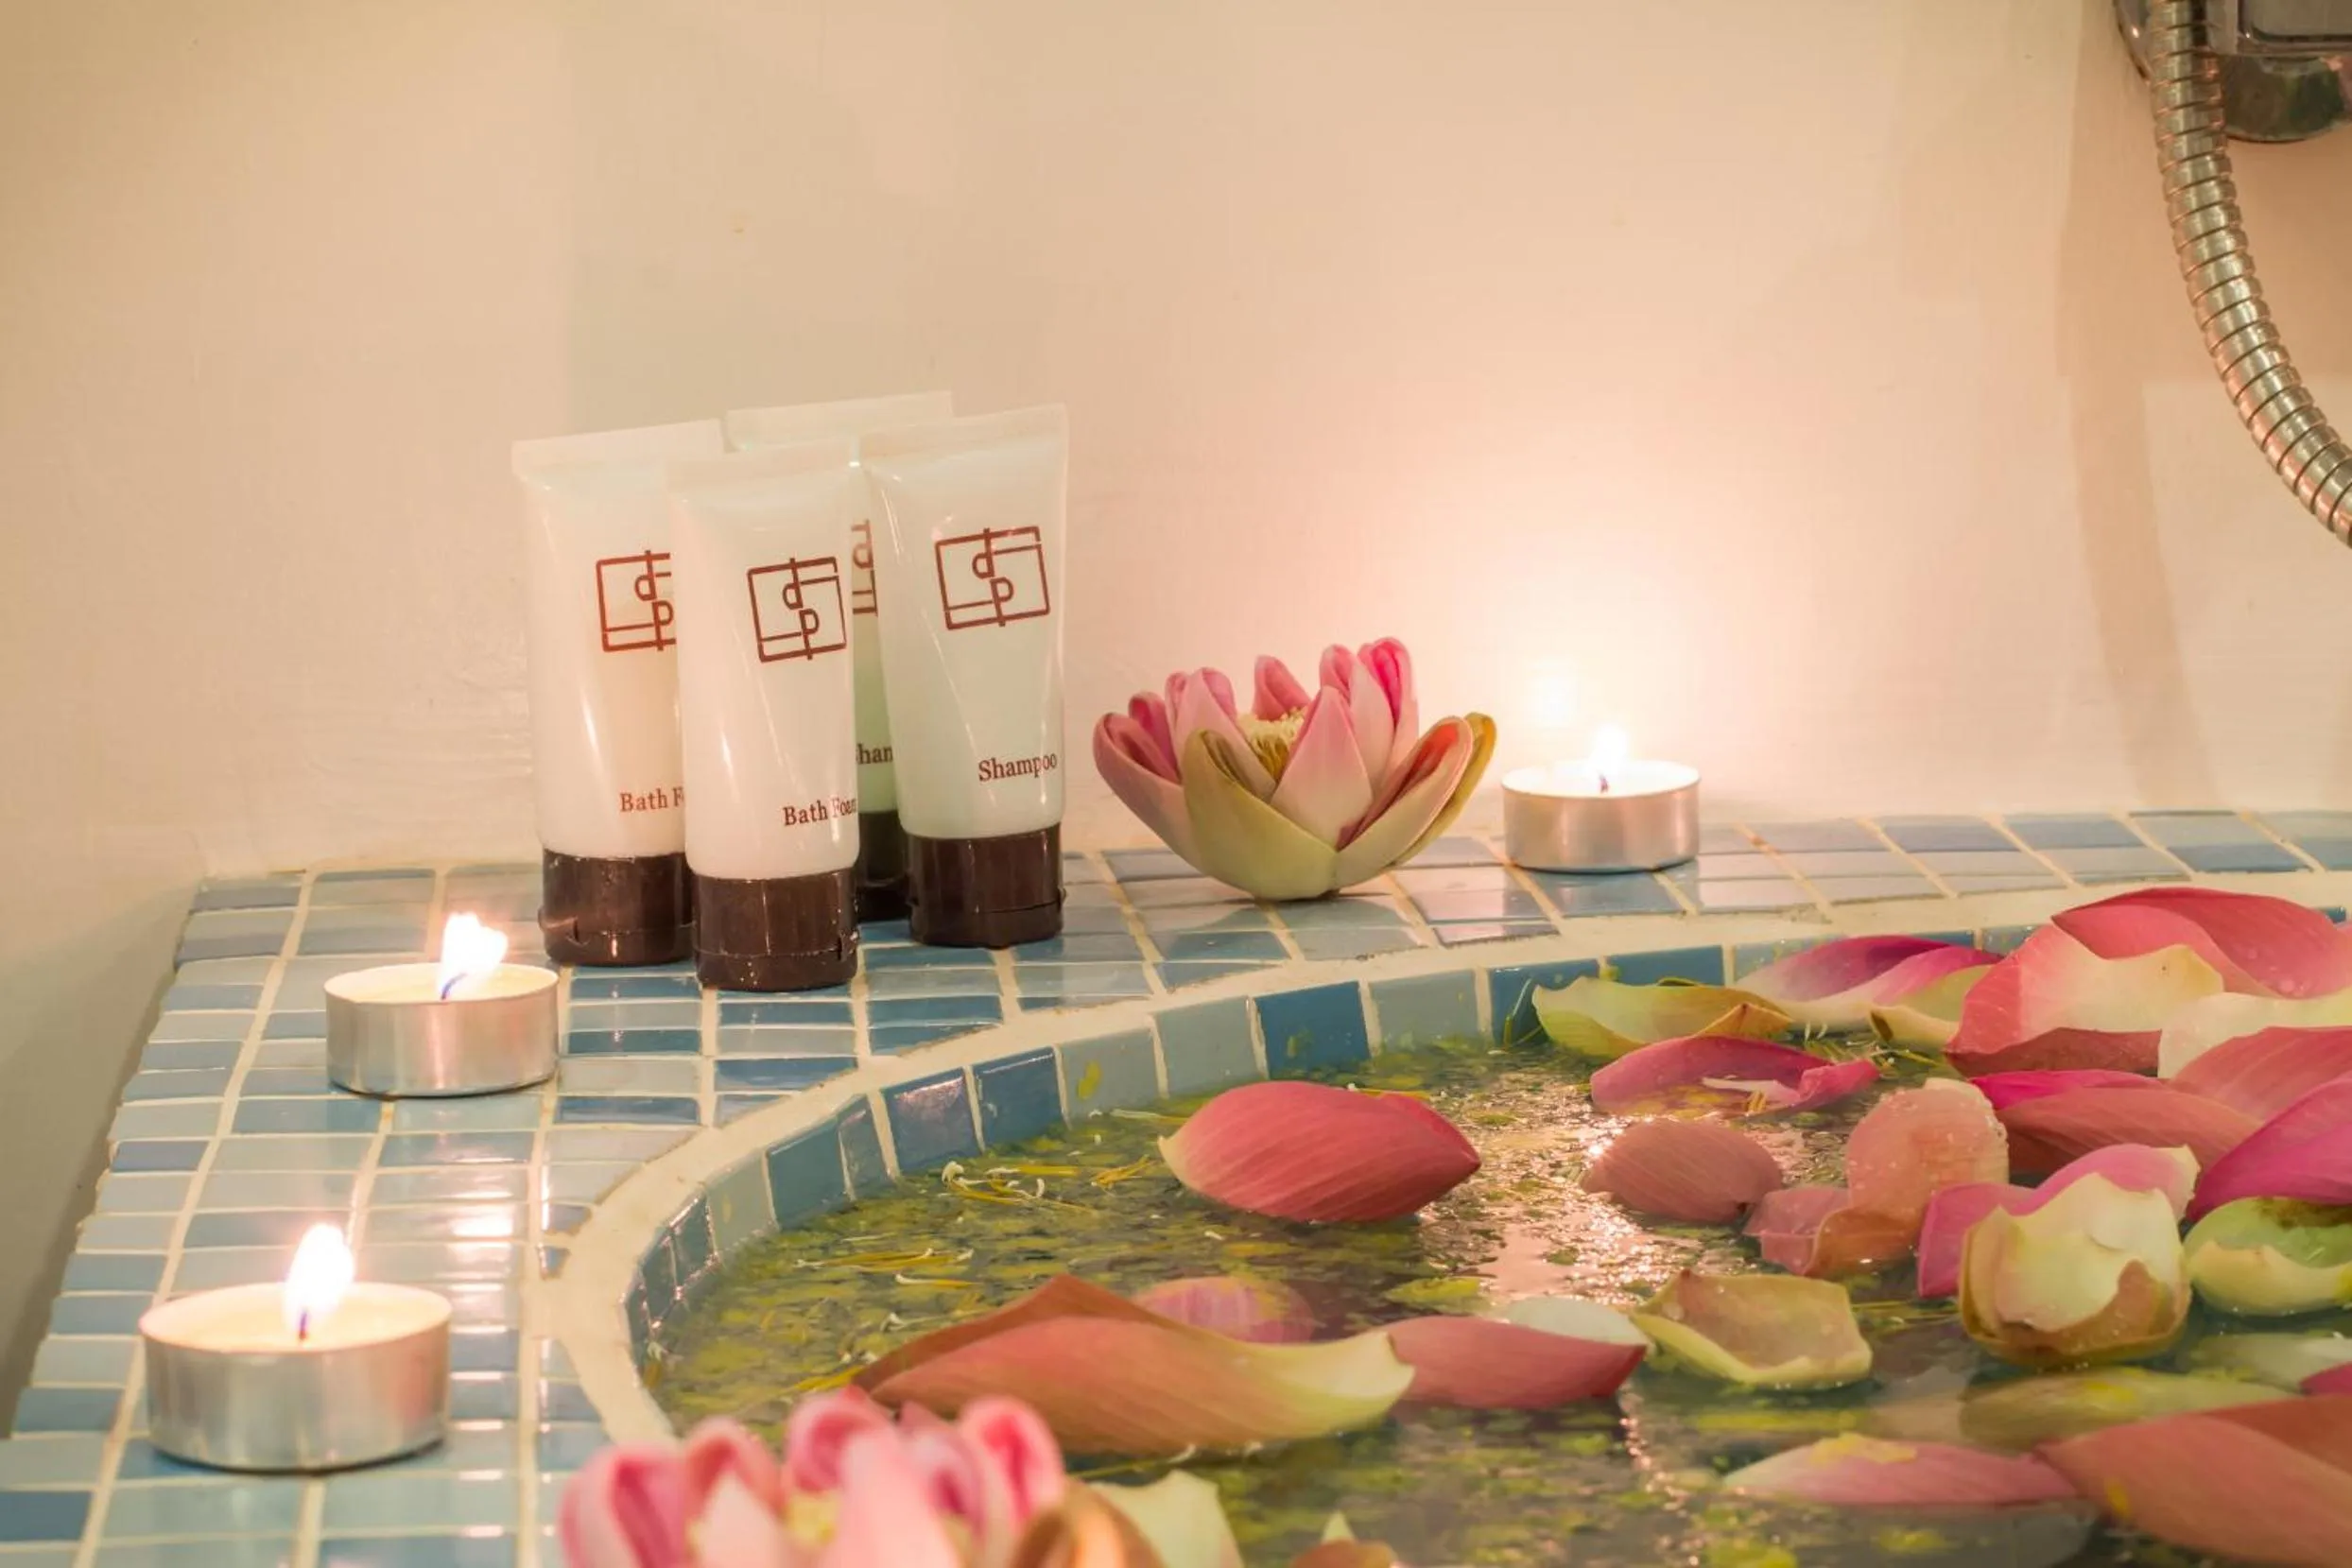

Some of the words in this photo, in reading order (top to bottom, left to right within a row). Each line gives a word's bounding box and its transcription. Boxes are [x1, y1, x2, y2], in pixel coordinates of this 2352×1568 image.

[978, 753, 1058, 782] Shampoo
[620, 787, 668, 812] Bath
[783, 800, 828, 826] Bath
